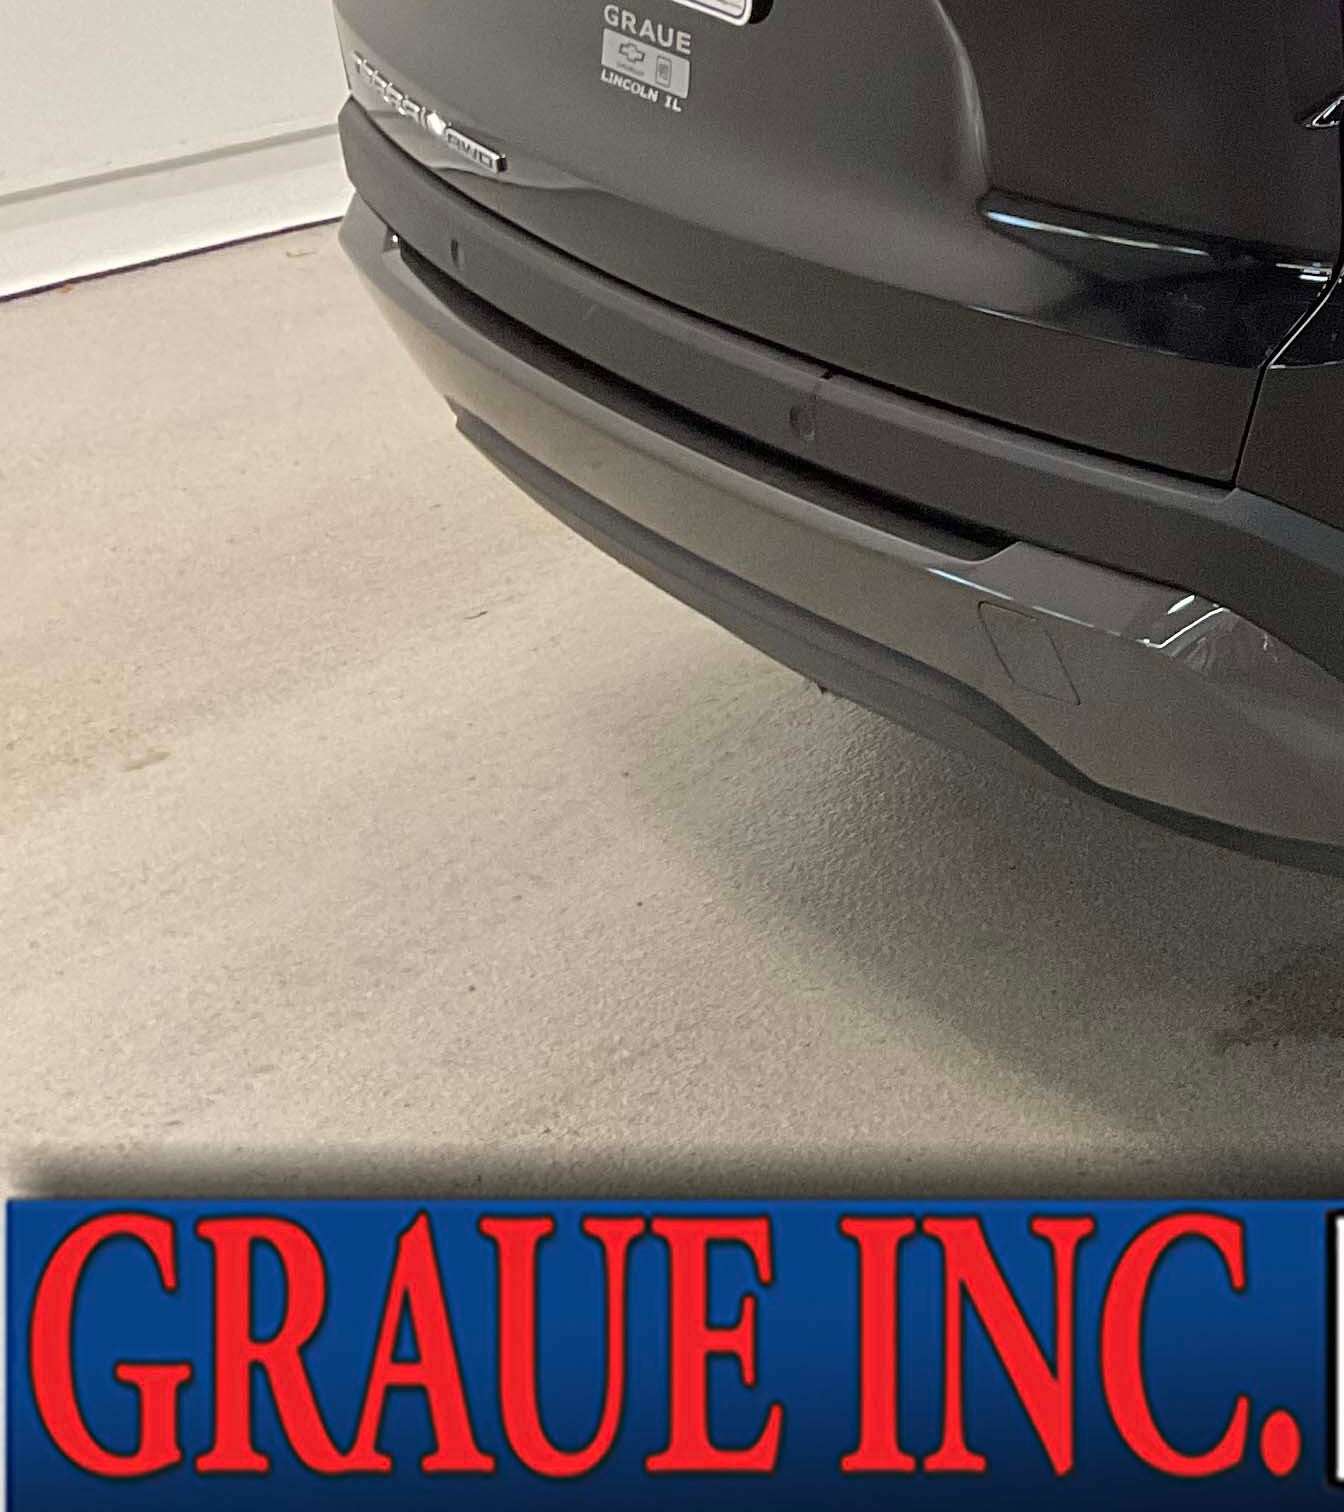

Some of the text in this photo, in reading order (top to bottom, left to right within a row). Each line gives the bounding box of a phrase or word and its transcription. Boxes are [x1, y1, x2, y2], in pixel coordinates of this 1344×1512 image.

[603, 3, 692, 55] GRAUE
[600, 68, 659, 103] LINCOLN
[664, 94, 682, 113] IL
